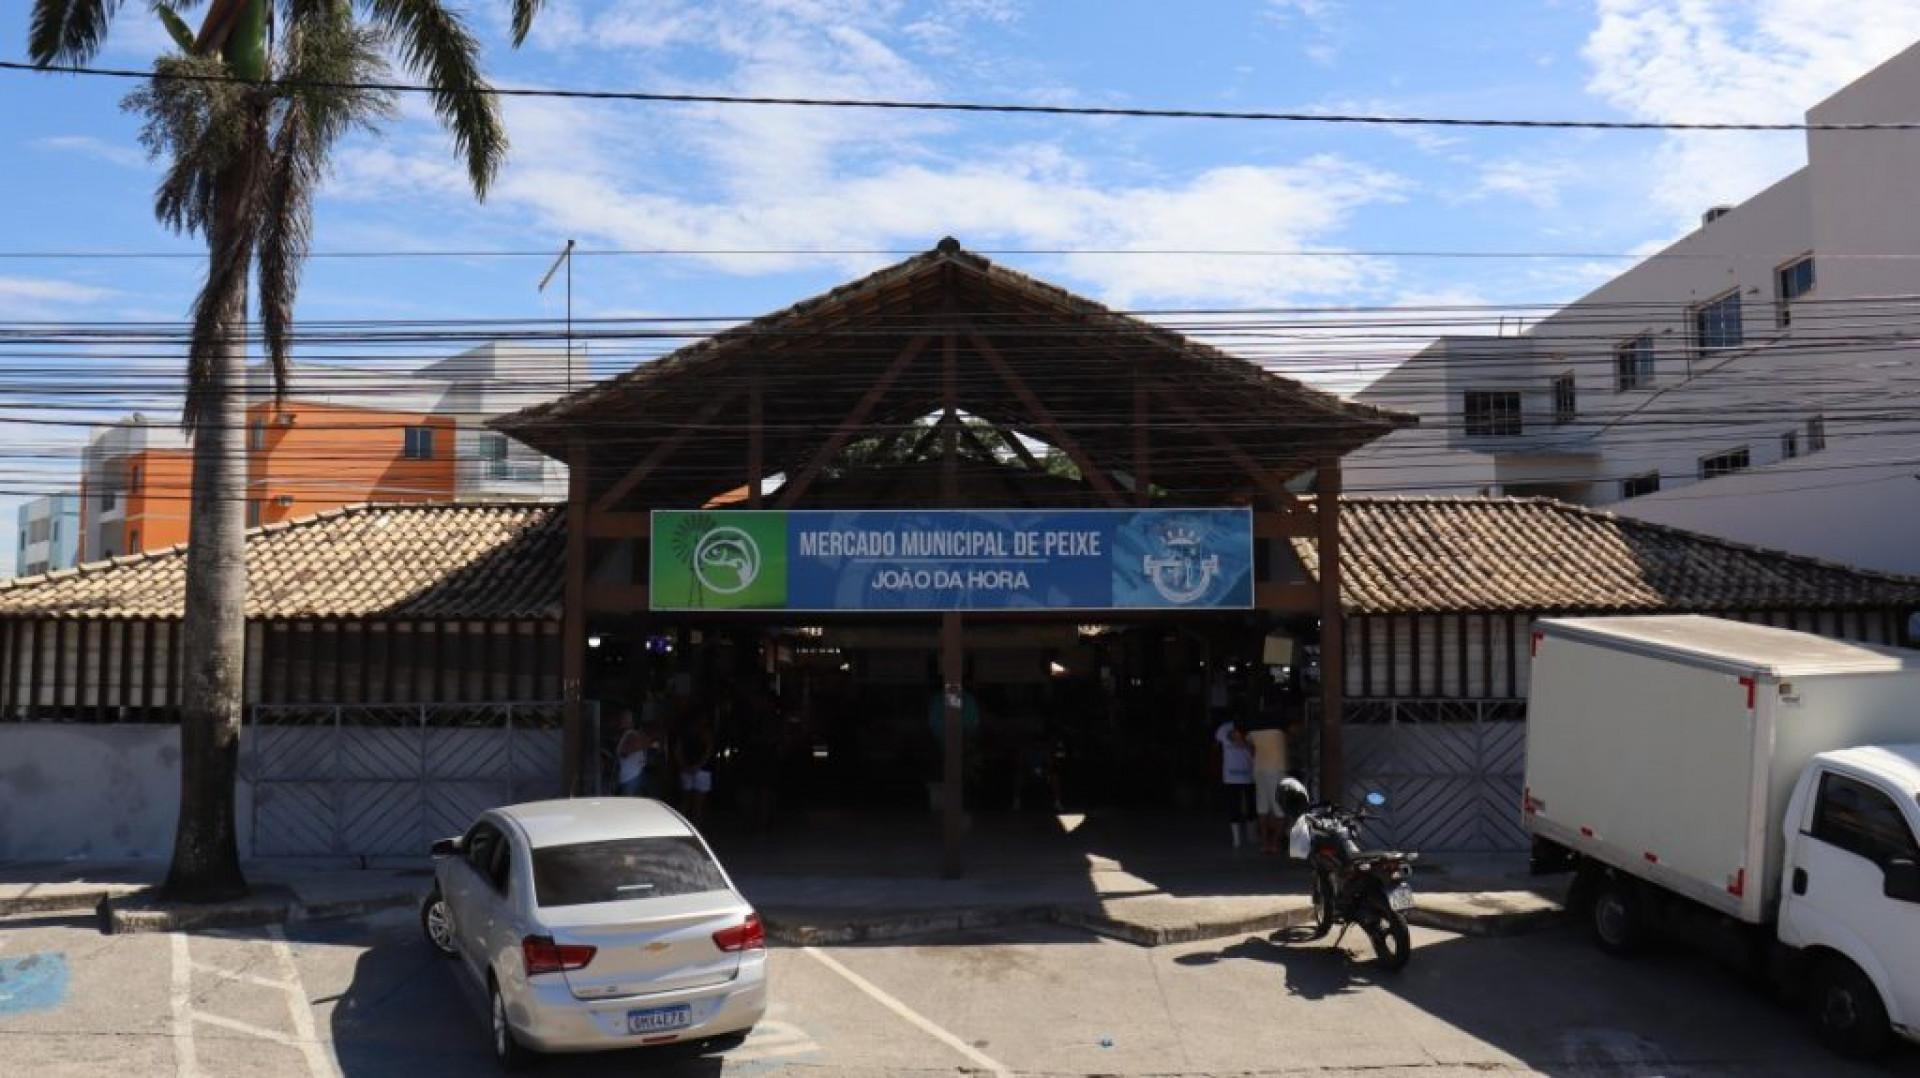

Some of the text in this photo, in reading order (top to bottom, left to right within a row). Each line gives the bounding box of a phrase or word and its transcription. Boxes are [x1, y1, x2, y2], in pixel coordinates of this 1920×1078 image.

[801, 532, 1101, 556] MERCADO MUNICIPAL DE PEIXE
[872, 567, 1030, 589] JOÃO DA HORA
